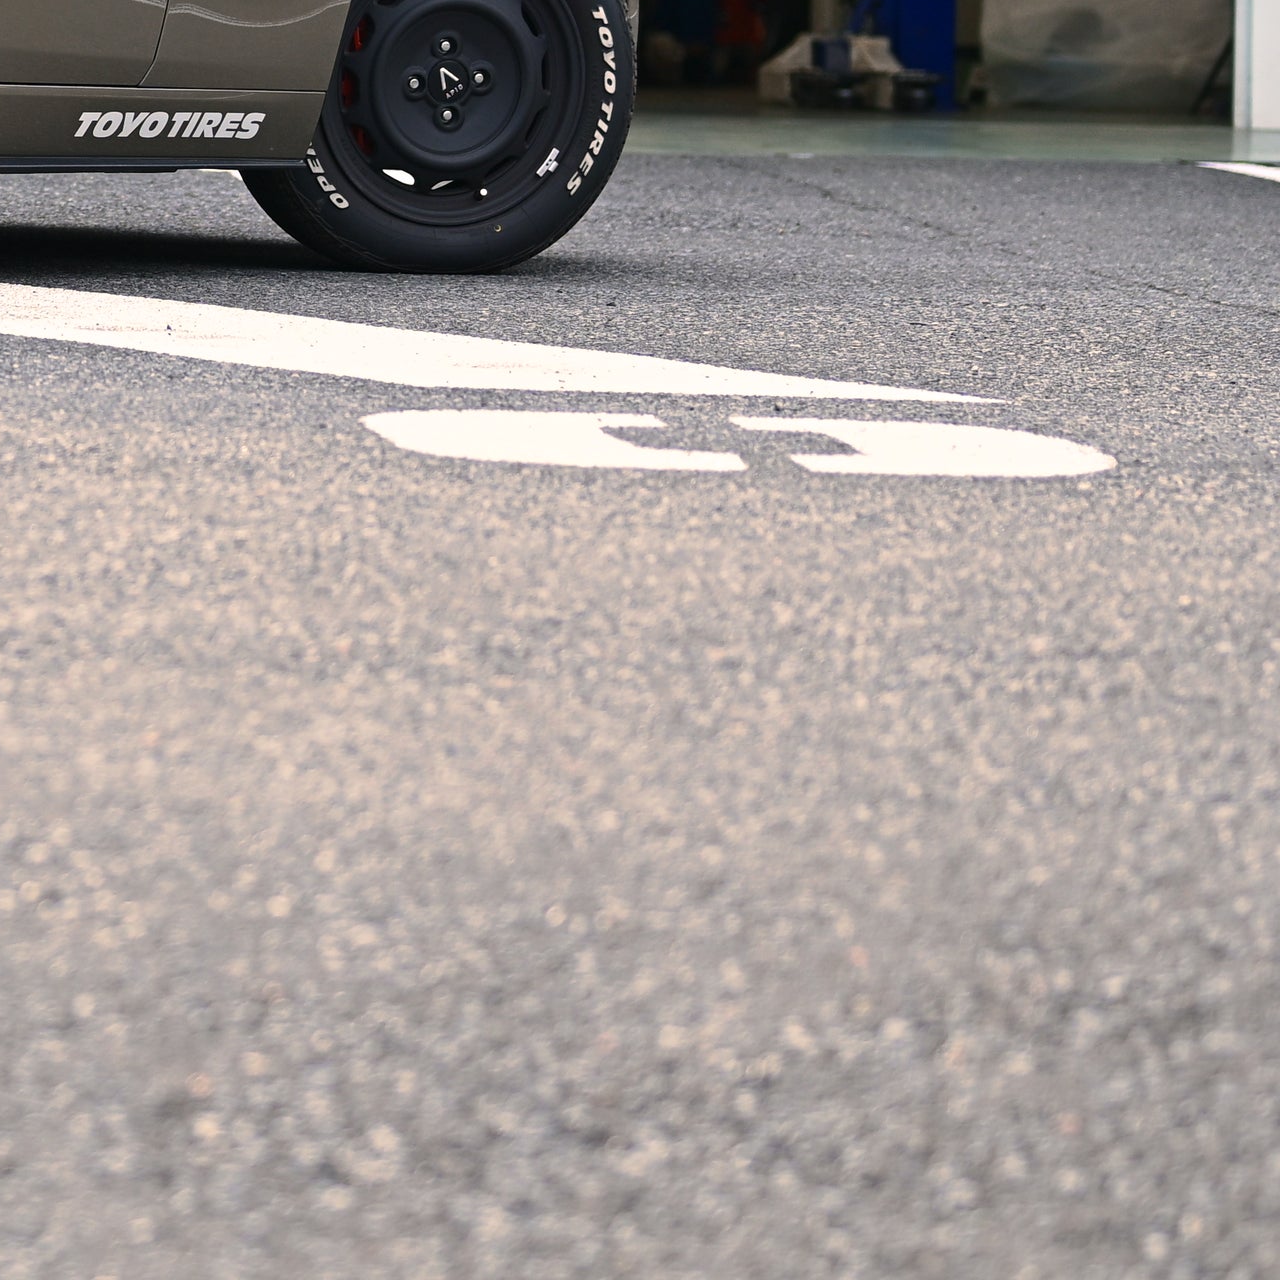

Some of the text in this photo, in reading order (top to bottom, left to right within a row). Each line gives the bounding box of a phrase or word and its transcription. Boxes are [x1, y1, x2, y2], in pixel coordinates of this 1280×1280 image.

[445, 83, 464, 99] APIO
[566, 6, 617, 196] TOYO TIRES
[73, 111, 267, 140] TOYO TIRES
